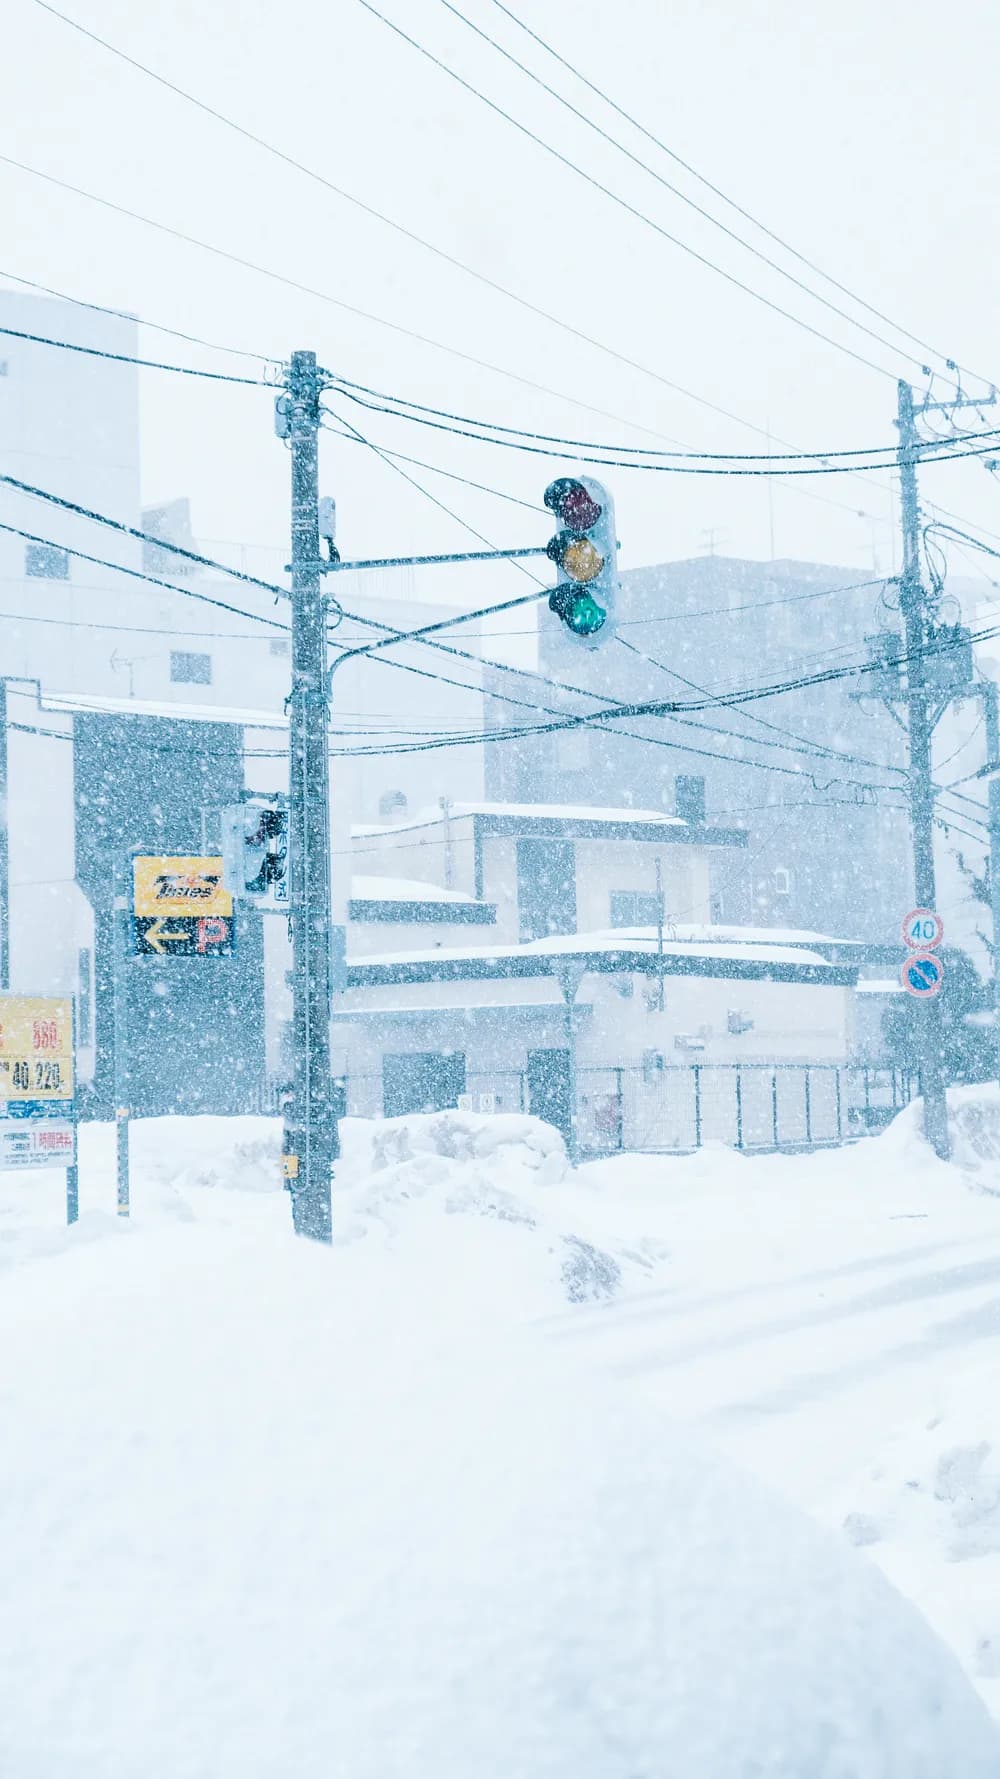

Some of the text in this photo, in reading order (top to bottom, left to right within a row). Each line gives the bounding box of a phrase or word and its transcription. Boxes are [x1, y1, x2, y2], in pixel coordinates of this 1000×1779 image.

[155, 875, 220, 899] Times
[197, 918, 227, 953] P
[911, 920, 935, 940] 40
